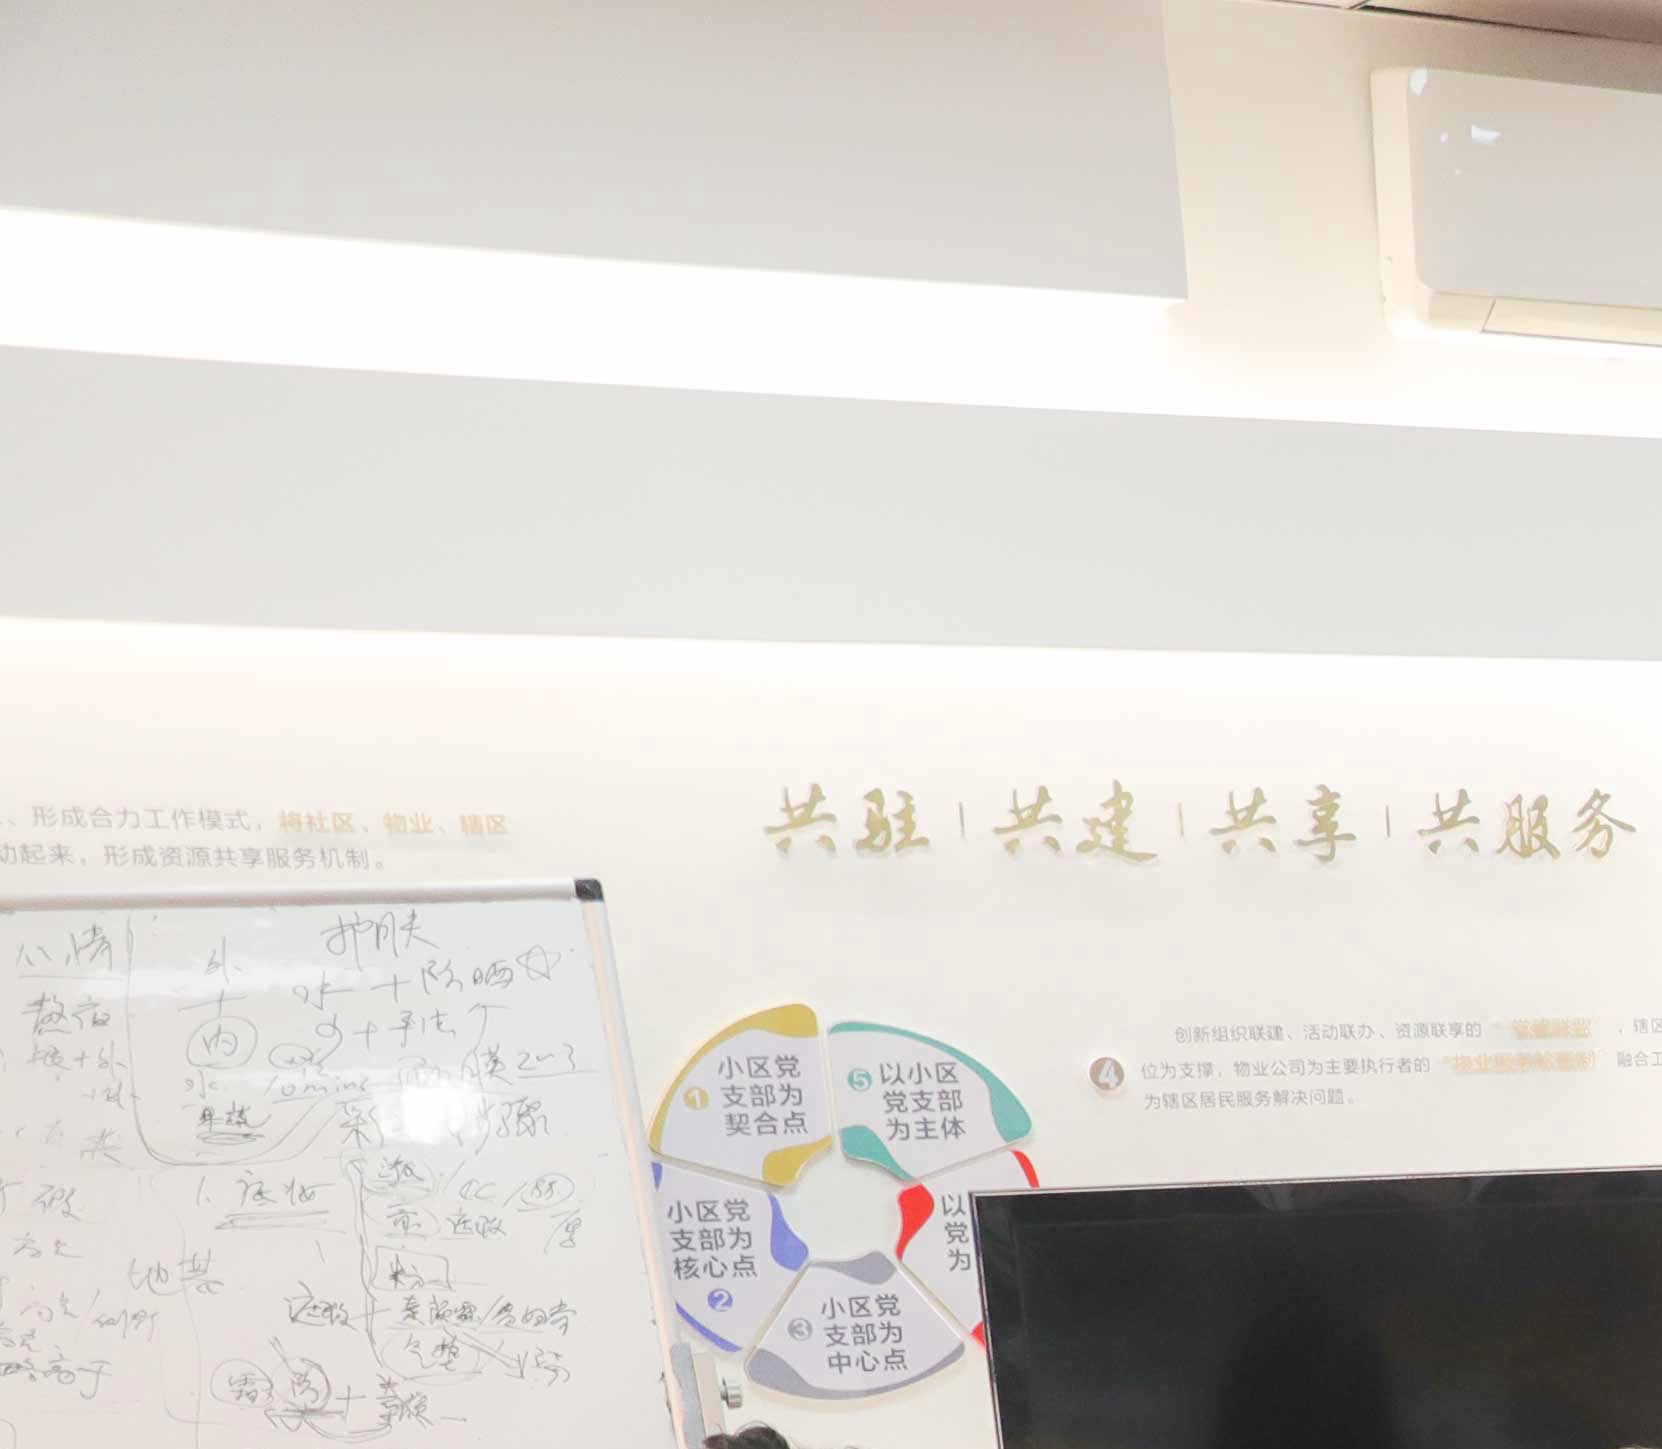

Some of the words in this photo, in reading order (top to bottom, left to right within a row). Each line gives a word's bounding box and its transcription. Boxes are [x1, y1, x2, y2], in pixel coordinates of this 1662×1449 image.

[762, 784, 932, 862] 共驻
[993, 779, 1161, 864] 共建
[1209, 785, 1358, 862] 共享
[1417, 787, 1638, 862] 共服务
[716, 1054, 801, 1080] 小区党
[878, 1061, 960, 1086] 以小区
[720, 1082, 803, 1108] 支部为
[881, 1088, 964, 1113] 党支部
[723, 1110, 809, 1137] 契合点
[886, 1115, 968, 1142] 为主体
[666, 1198, 751, 1225] 小区党
[940, 1192, 968, 1217] 以
[670, 1227, 754, 1254] 支部为
[943, 1222, 970, 1246] 党
[672, 1255, 759, 1282] 核心点
[946, 1248, 972, 1273] 为
[819, 1293, 901, 1320] 小区党
[823, 1321, 903, 1348] 支部为
[826, 1349, 909, 1376] 中心点
